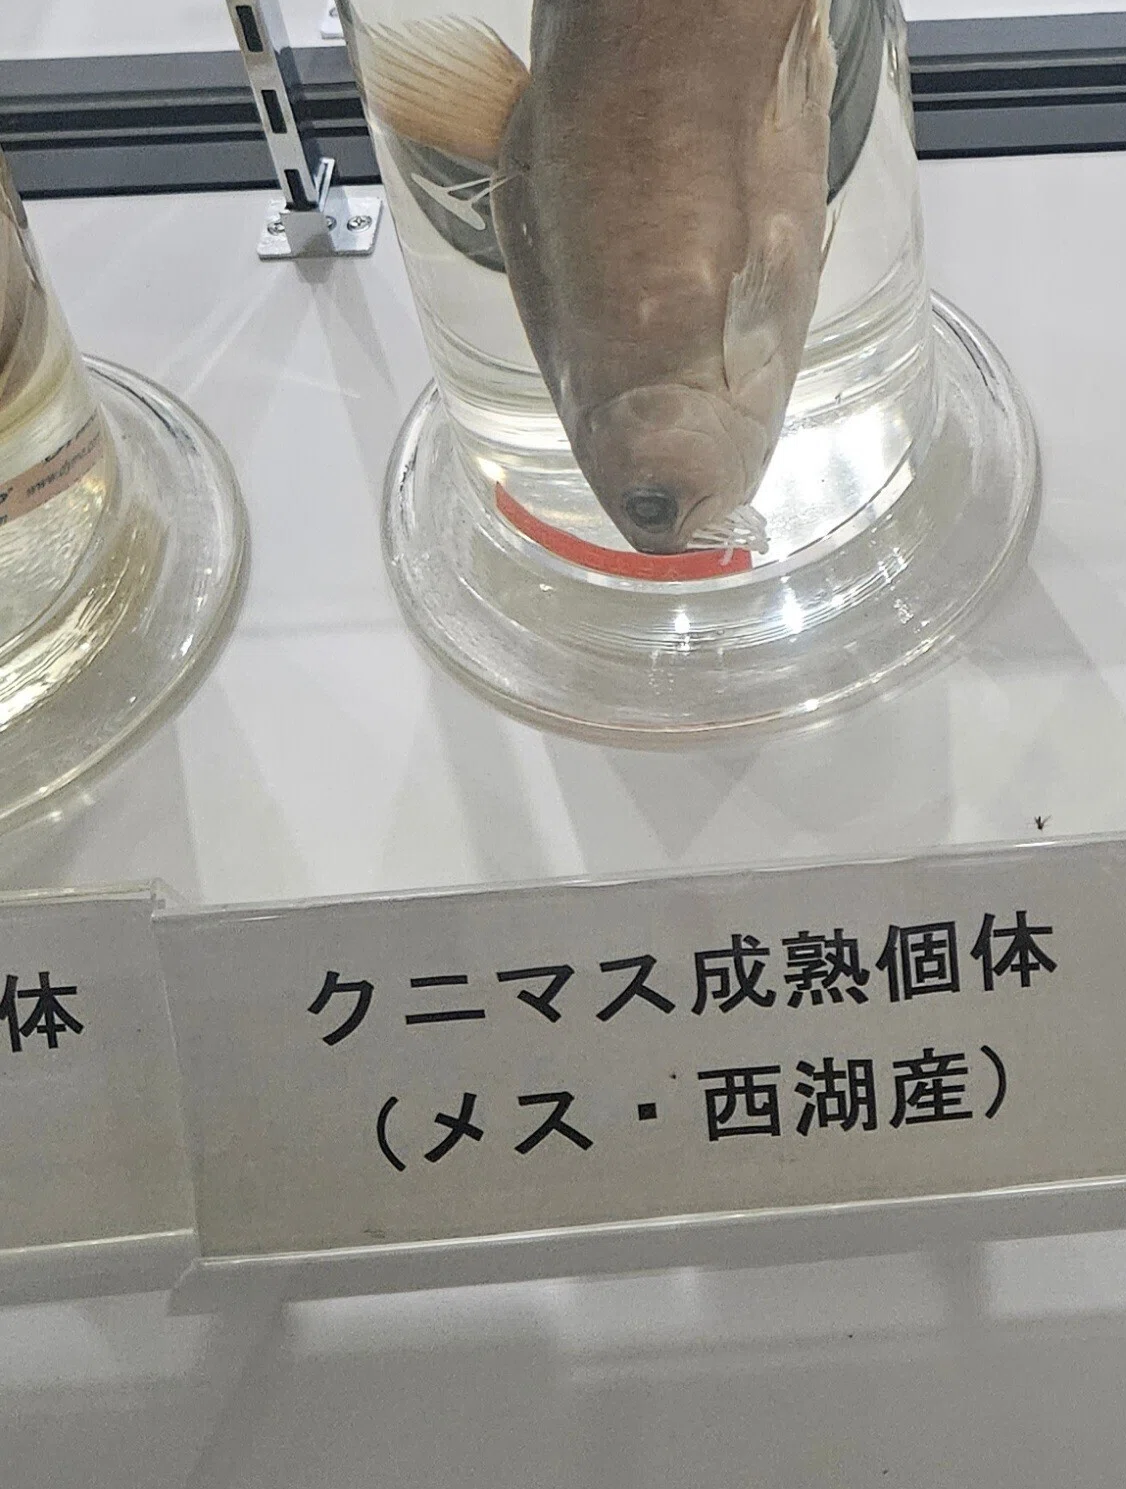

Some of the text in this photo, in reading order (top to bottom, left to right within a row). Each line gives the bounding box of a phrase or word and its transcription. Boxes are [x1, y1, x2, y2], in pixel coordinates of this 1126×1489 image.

[305, 910, 1058, 1046] クニマス成熟個体
